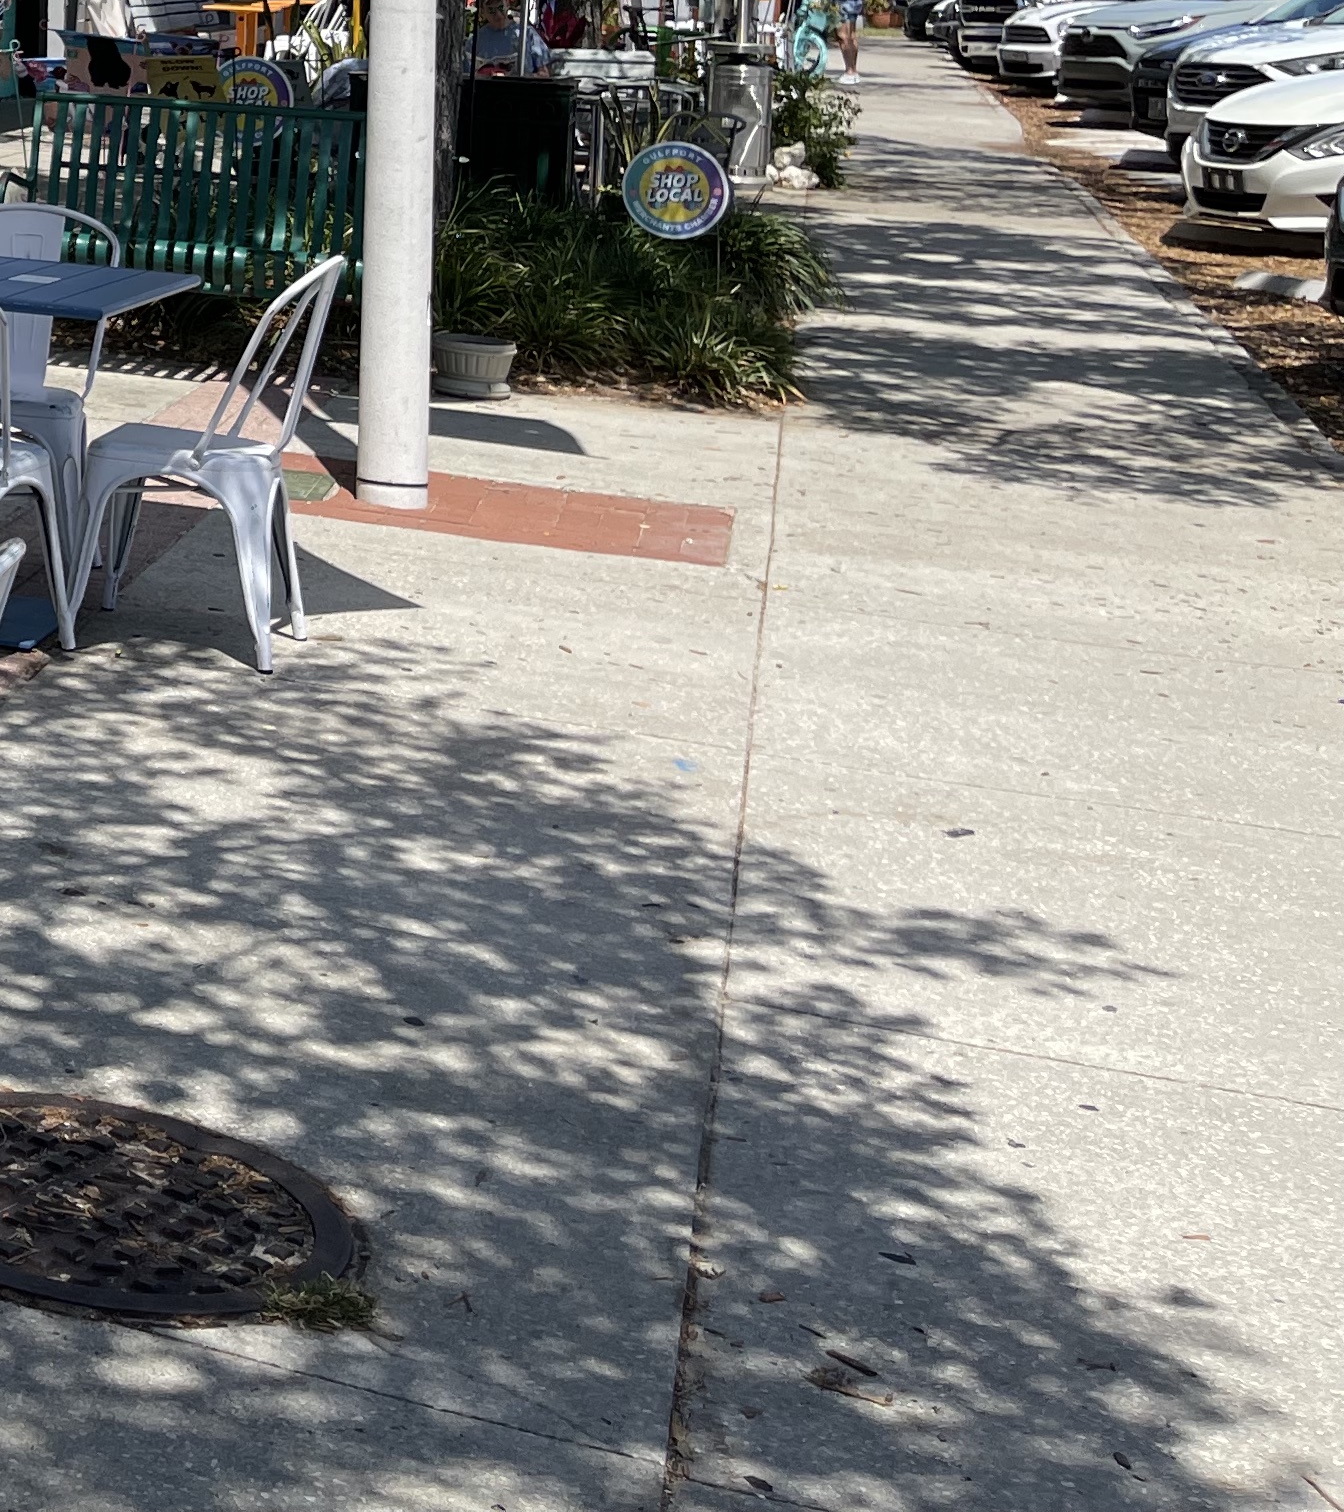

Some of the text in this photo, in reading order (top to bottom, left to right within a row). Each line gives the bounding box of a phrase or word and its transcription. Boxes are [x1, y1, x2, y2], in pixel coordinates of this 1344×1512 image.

[227, 86, 269, 101] SHOP
[650, 172, 700, 189] SHOP
[647, 187, 704, 204] LOCAL
